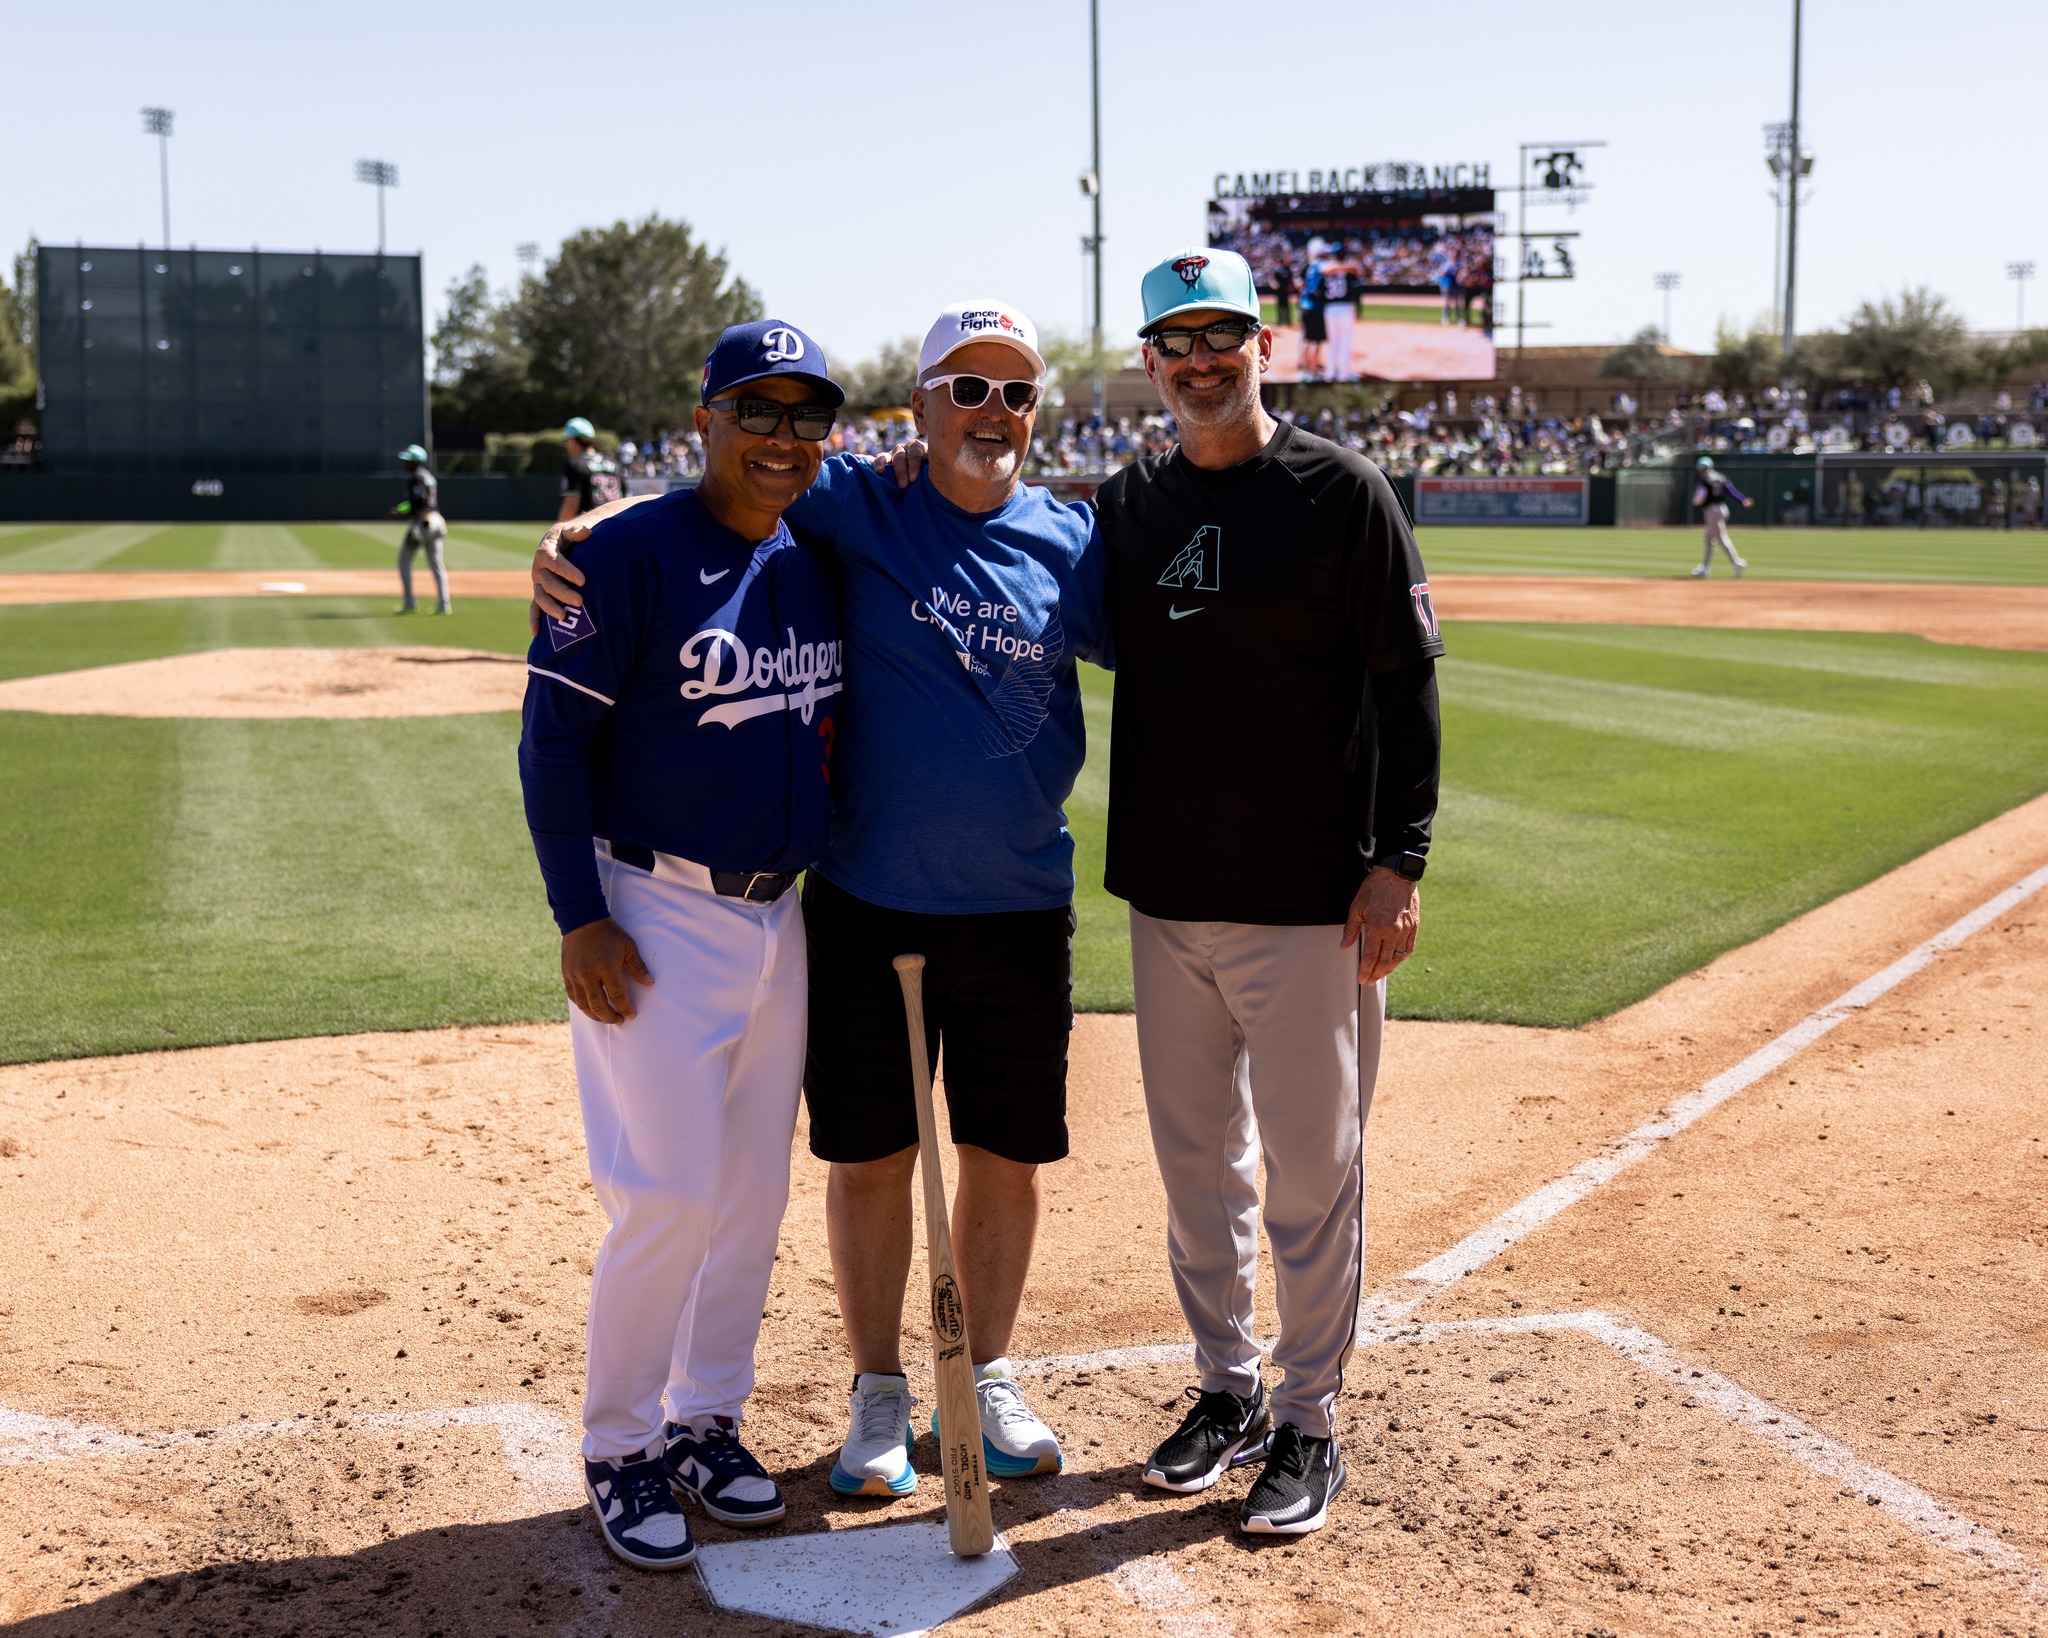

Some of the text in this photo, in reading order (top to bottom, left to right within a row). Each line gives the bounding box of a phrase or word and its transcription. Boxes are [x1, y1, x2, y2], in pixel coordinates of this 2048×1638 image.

[1214, 163, 1490, 198] CAMELBACK RANCH
[961, 318, 1024, 338] Fightrs
[962, 311, 999, 320] Cancer
[762, 328, 805, 362] D
[931, 586, 1018, 623] We are
[1409, 583, 1438, 637] 17
[981, 626, 1044, 661] Hope
[679, 627, 843, 726] Dodger
[937, 1288, 948, 1332] Slugger
[945, 1281, 960, 1338] Louisville
[950, 1448, 961, 1496] PRO STOCK
[960, 1443, 969, 1473] MODEL
